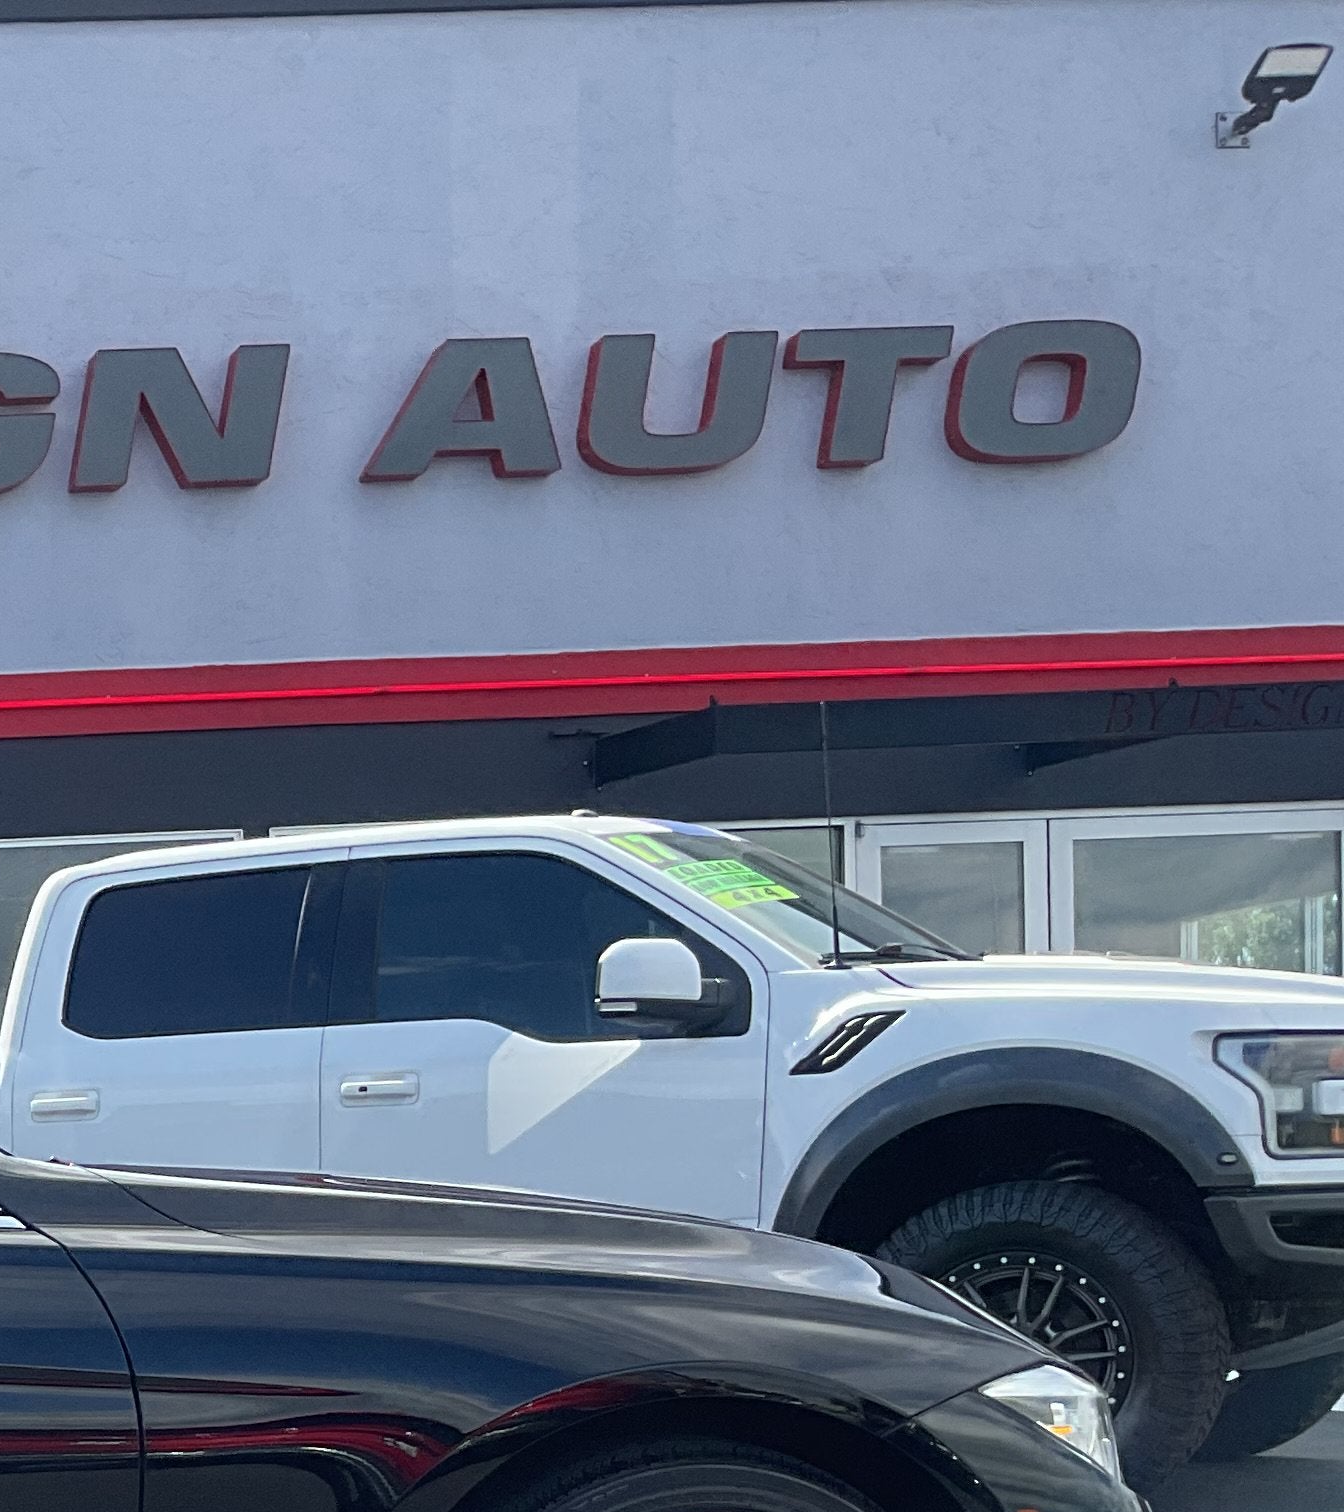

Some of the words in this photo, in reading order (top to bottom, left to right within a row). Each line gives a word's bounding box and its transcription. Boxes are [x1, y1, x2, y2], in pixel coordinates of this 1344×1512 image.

[358, 319, 1143, 484] AUTO
[1104, 689, 1178, 735] BY
[1189, 684, 1343, 730] DESIG
[608, 834, 680, 864] 17
[667, 861, 747, 880] LOADED
